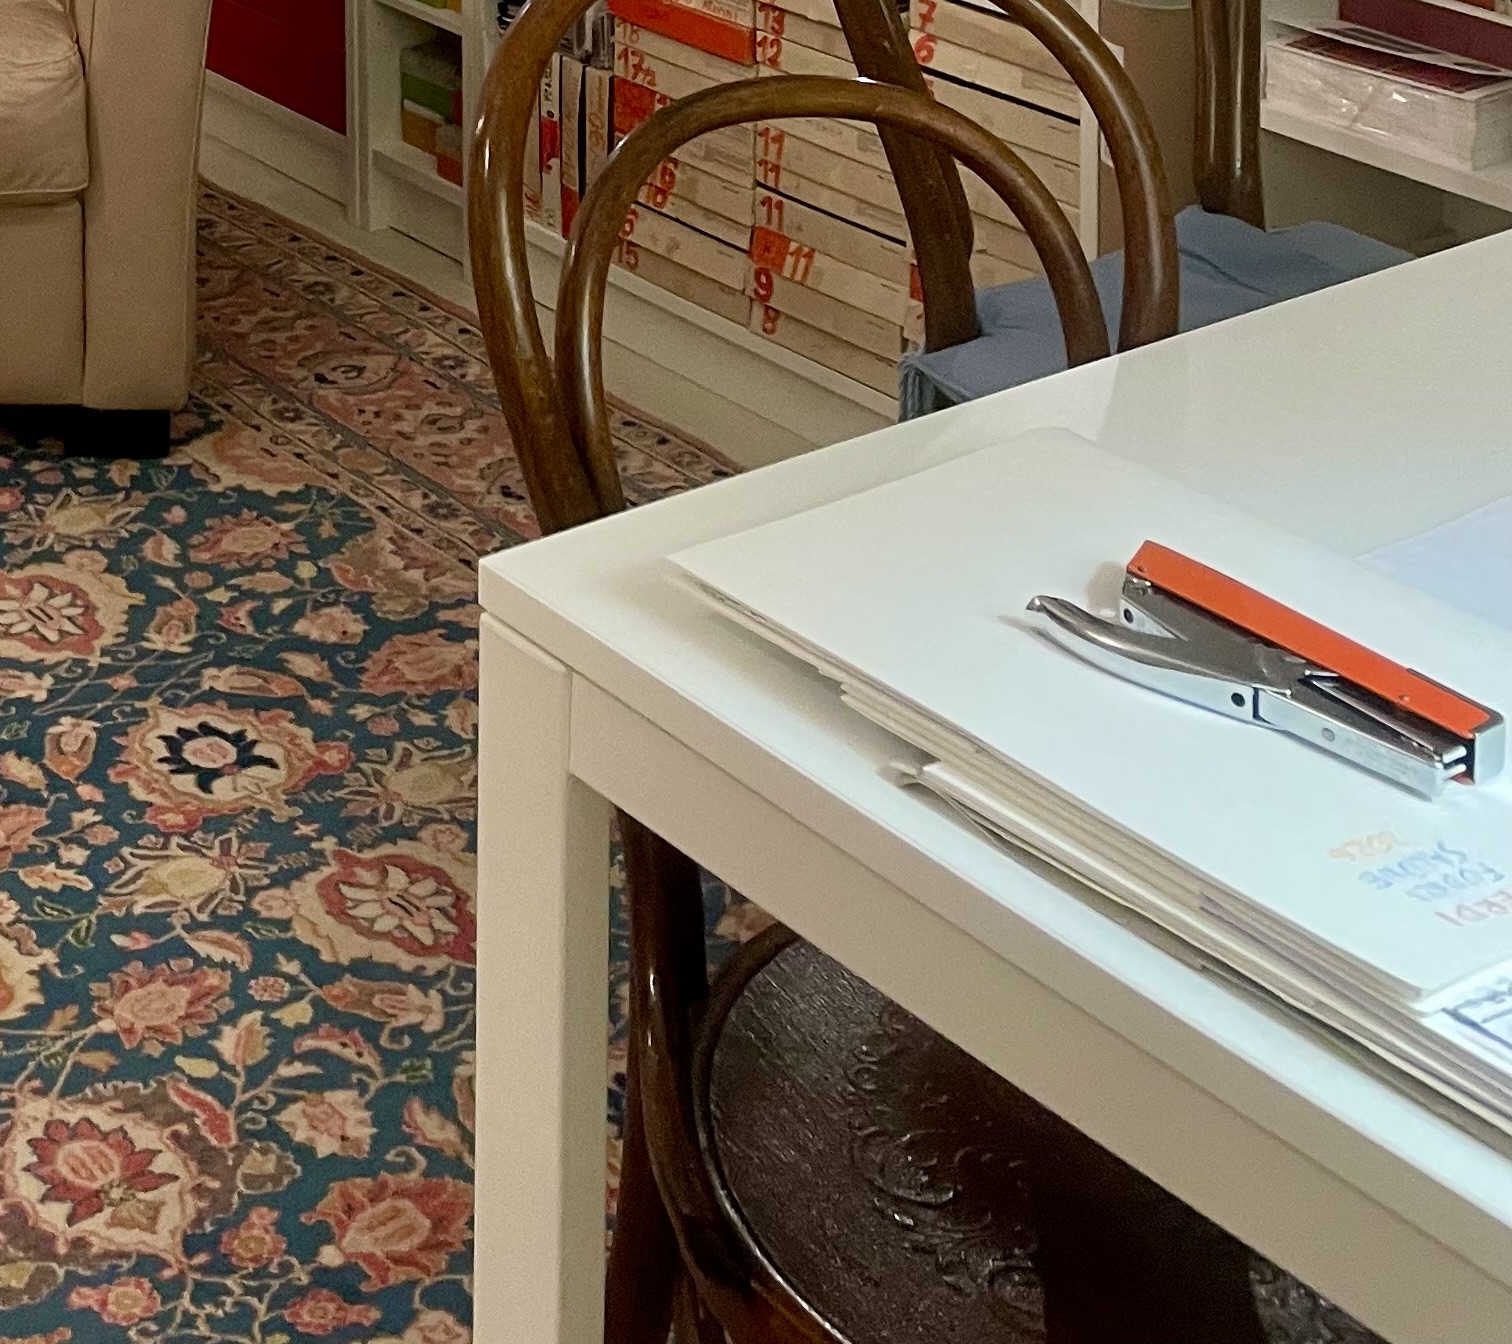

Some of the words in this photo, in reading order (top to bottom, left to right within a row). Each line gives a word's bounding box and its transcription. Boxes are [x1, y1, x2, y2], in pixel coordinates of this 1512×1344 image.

[758, 4, 786, 36] 13
[756, 35, 783, 68] 12
[914, 34, 937, 64] 6
[758, 126, 786, 162] 11
[758, 158, 782, 189] 11
[760, 195, 785, 233] 11
[788, 246, 816, 285] 11
[753, 266, 774, 302] 9
